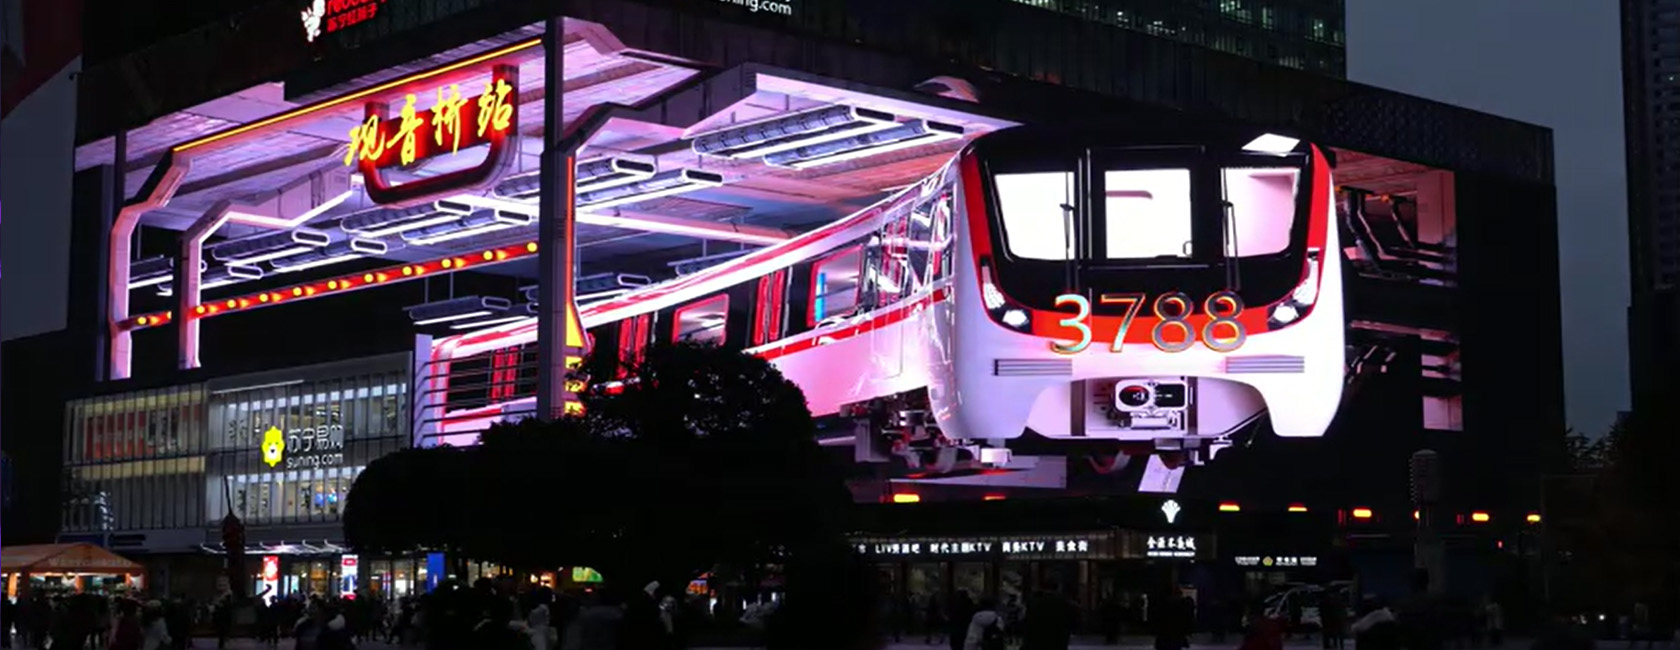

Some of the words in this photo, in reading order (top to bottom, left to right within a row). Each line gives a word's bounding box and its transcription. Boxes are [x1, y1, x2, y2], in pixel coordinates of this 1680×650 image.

[344, 78, 514, 167] 观音桥站
[1050, 291, 1248, 355] 3788
[286, 424, 344, 453] 苏宁易购
[286, 452, 344, 470] suning.com
